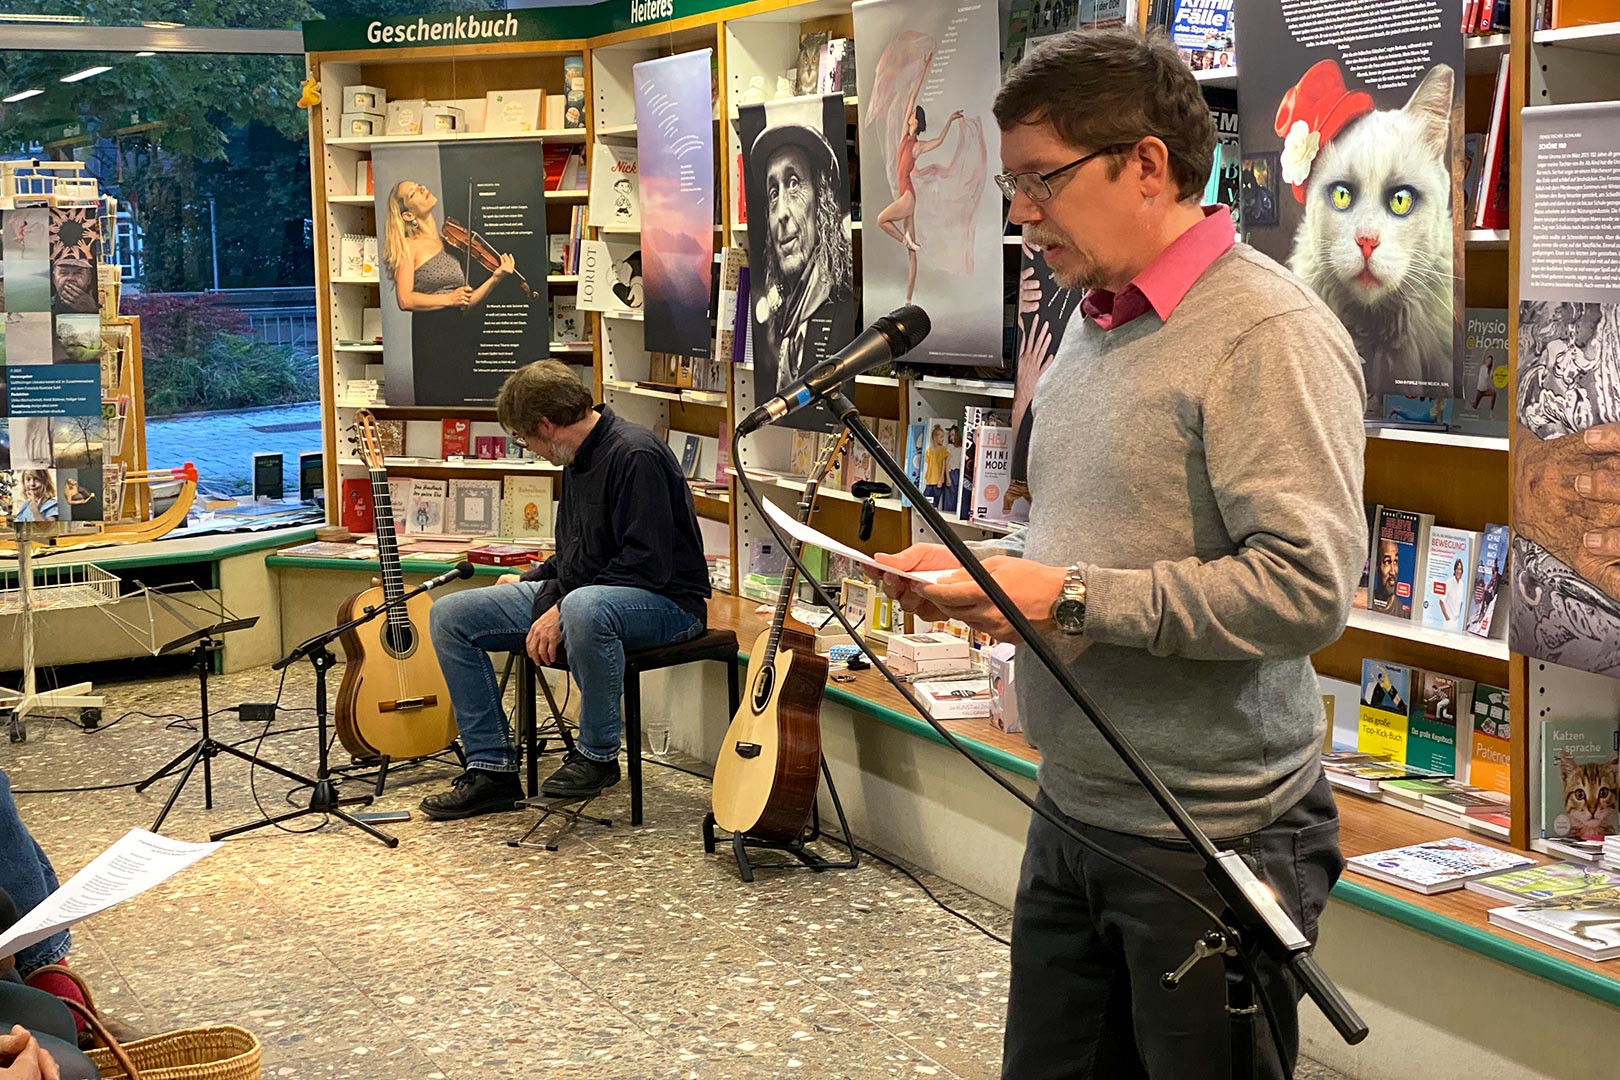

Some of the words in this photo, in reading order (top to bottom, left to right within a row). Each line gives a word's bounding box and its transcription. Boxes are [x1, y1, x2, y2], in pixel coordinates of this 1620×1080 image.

[631, 0, 674, 23] Heiteres
[1174, 8, 1226, 27] Fälle
[367, 12, 518, 43] Geschenkbuch
[611, 160, 638, 174] Nick
[583, 247, 597, 303] LORIOT
[1467, 319, 1506, 336] Physio
[987, 433, 1008, 446] HEJ
[985, 450, 1009, 460] MINI
[985, 461, 1007, 470] MODE
[1362, 714, 1373, 724] Das
[1374, 718, 1391, 728] große
[1362, 724, 1403, 742] Tipp-Kick-Buch
[1411, 727, 1419, 735] Das
[1419, 731, 1431, 739] große
[1553, 730, 1585, 741] Katzen
[1565, 741, 1601, 755] sprache
